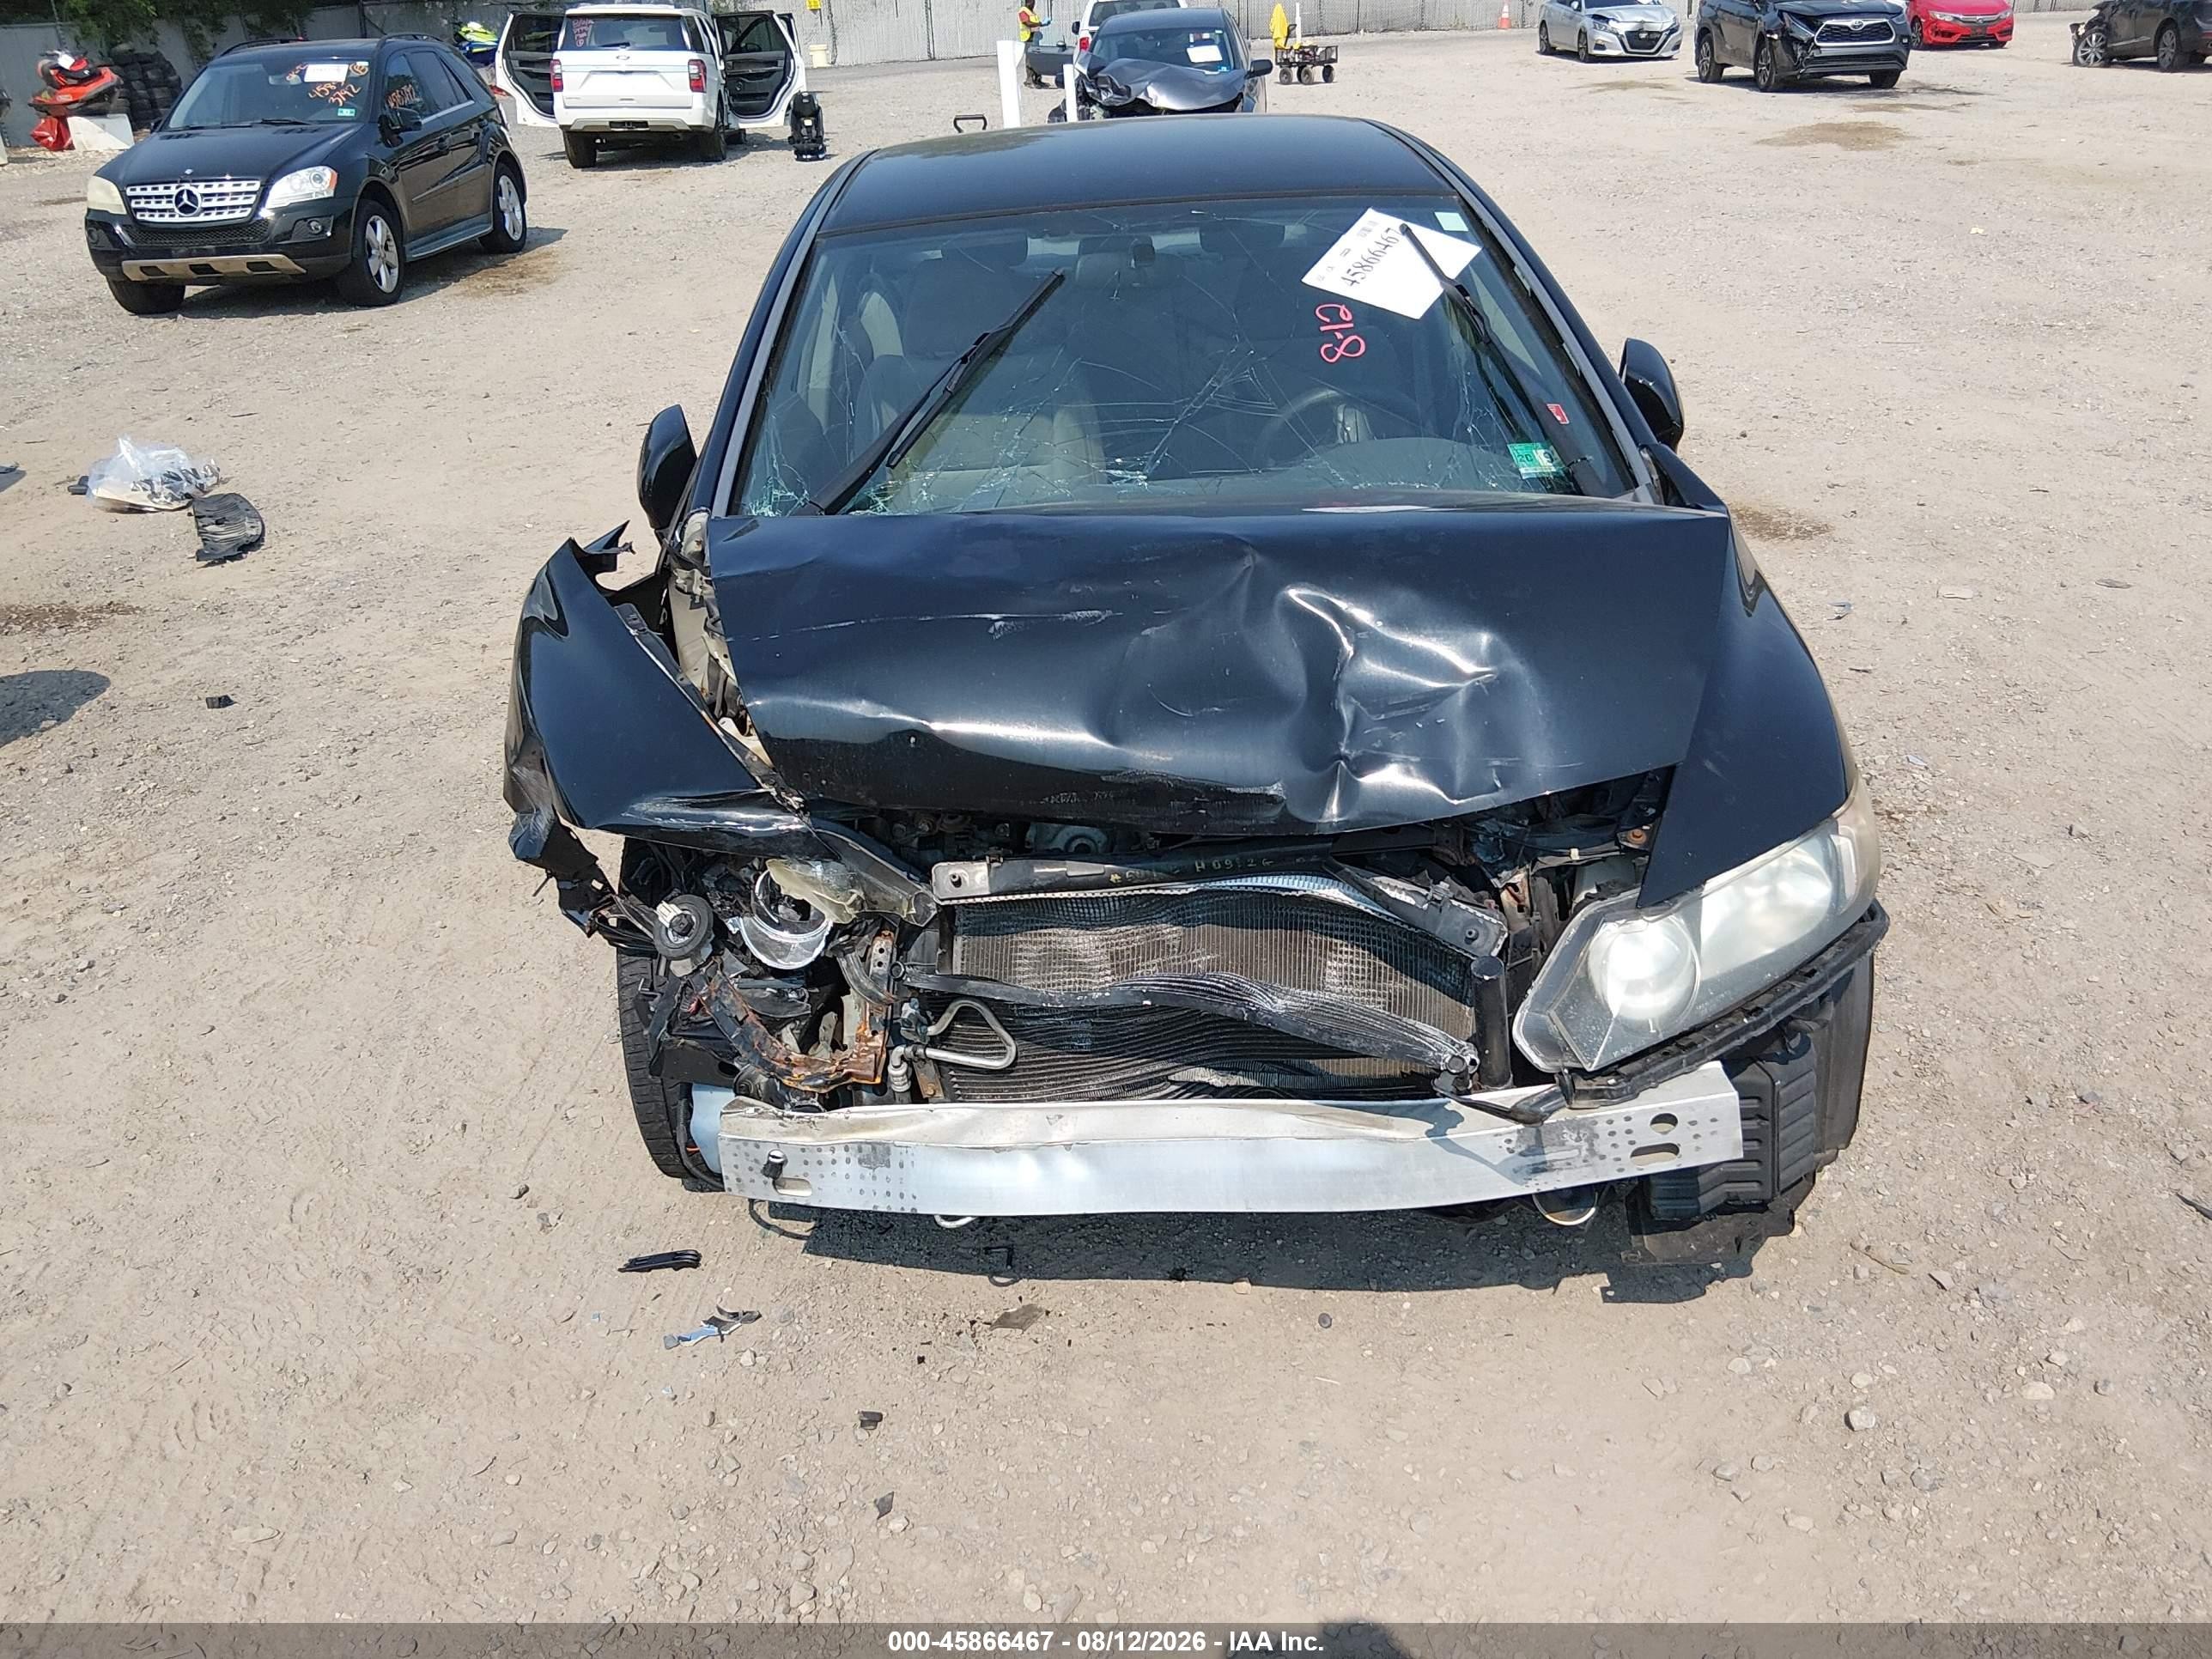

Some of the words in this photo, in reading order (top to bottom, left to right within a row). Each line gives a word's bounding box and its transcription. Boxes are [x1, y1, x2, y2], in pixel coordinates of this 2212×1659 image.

[308, 82, 344, 98] 458
[1340, 228, 1402, 287] 45866467
[1316, 303, 1366, 363] 8-12
